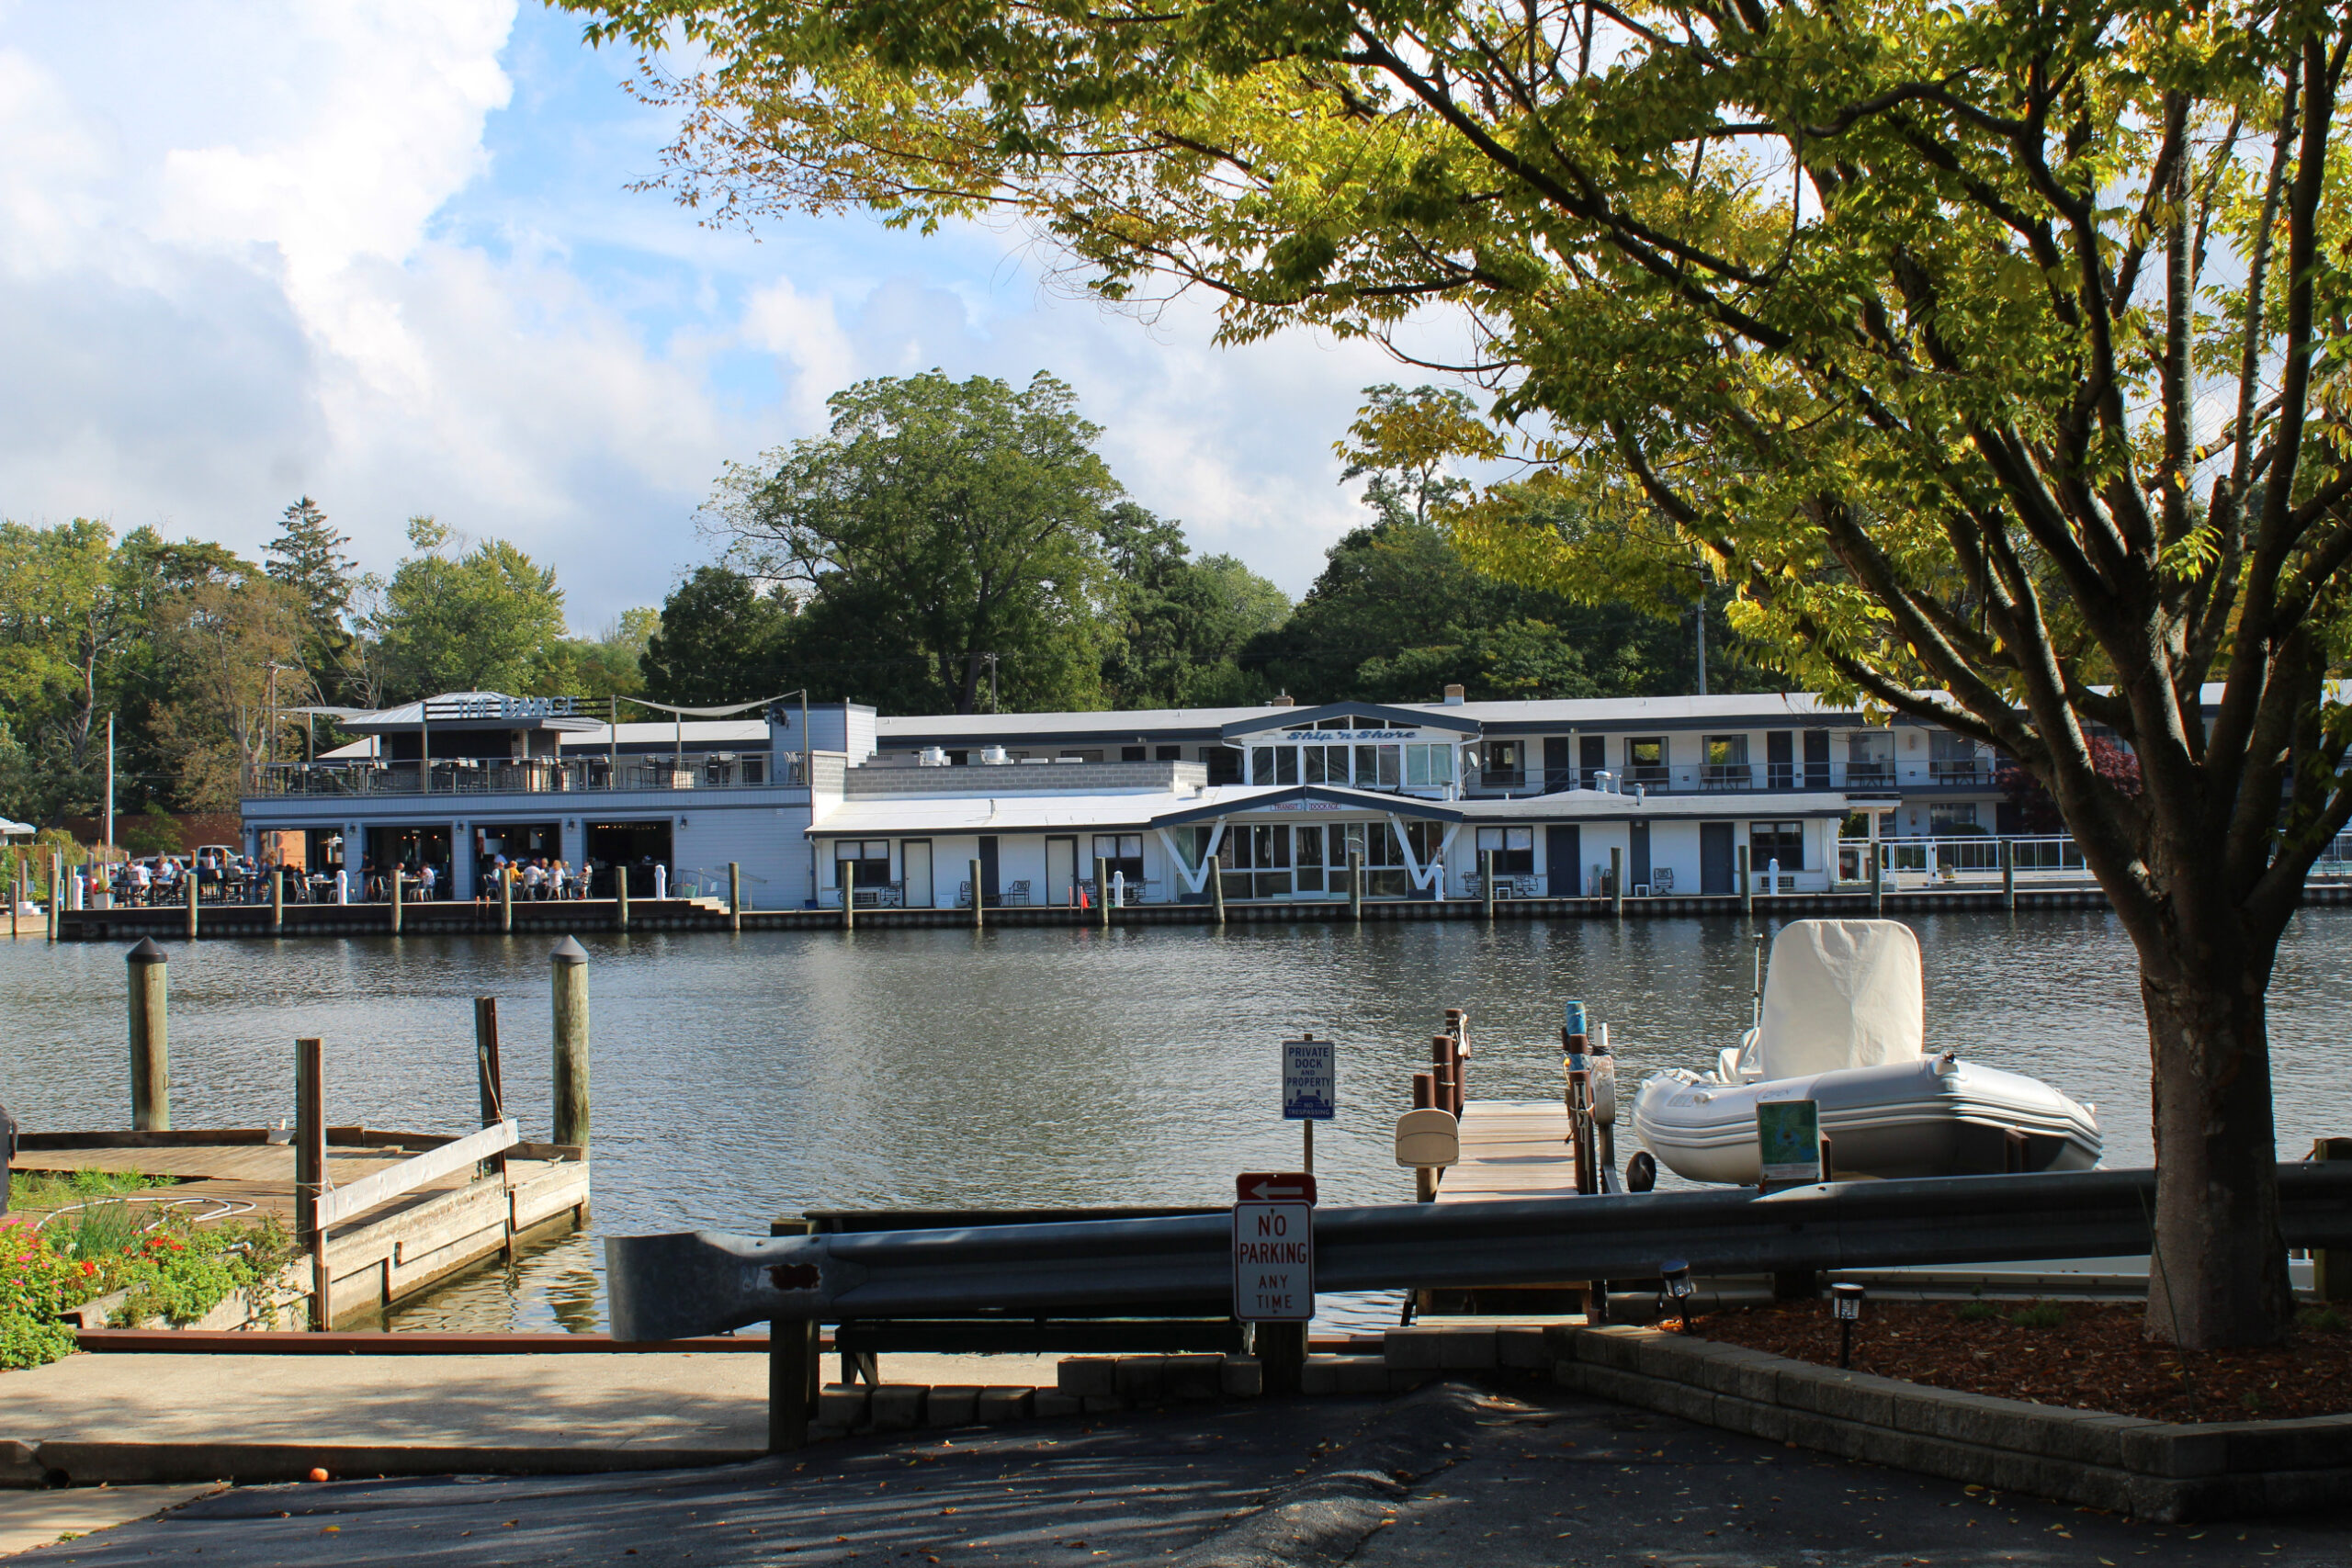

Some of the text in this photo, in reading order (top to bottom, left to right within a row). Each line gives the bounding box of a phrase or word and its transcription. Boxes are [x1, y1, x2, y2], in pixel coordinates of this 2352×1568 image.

[456, 696, 579, 717] THE BARGE
[1287, 731, 1333, 741] Ship
[1356, 730, 1416, 739] Shore
[1310, 802, 1340, 810] DOCKAGE
[1288, 1047, 1329, 1057] PRIVATE
[1295, 1058, 1323, 1068] DOCK
[1286, 1077, 1330, 1087] PROPERTY
[1258, 1214, 1286, 1236] NO
[1239, 1242, 1306, 1264] PARKING
[1259, 1274, 1288, 1289] ANY
[1256, 1294, 1293, 1309] TIME
